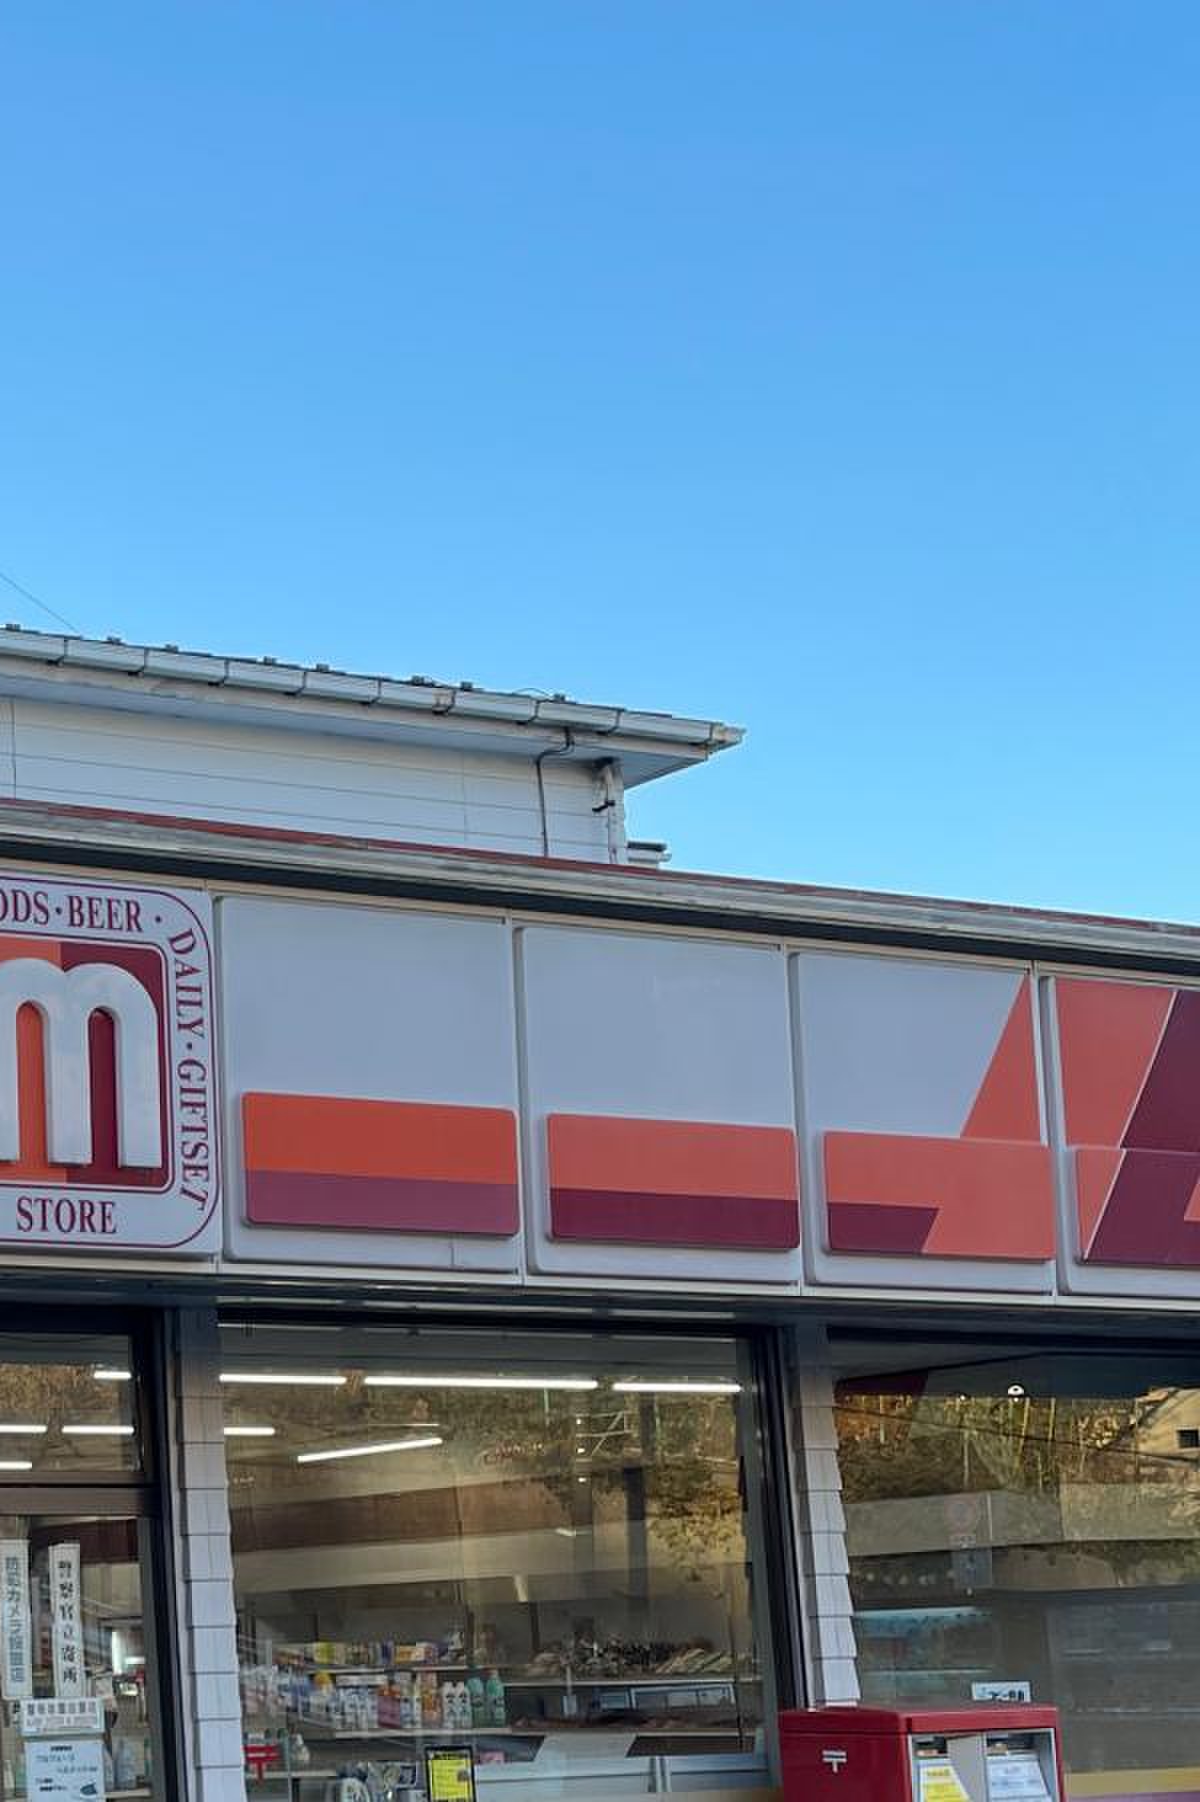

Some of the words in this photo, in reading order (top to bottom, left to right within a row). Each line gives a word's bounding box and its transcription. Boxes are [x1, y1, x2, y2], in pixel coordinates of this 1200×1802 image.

[67, 895, 144, 933] BEER
[168, 928, 205, 1039] DAILY
[16, 1194, 117, 1235] STORE
